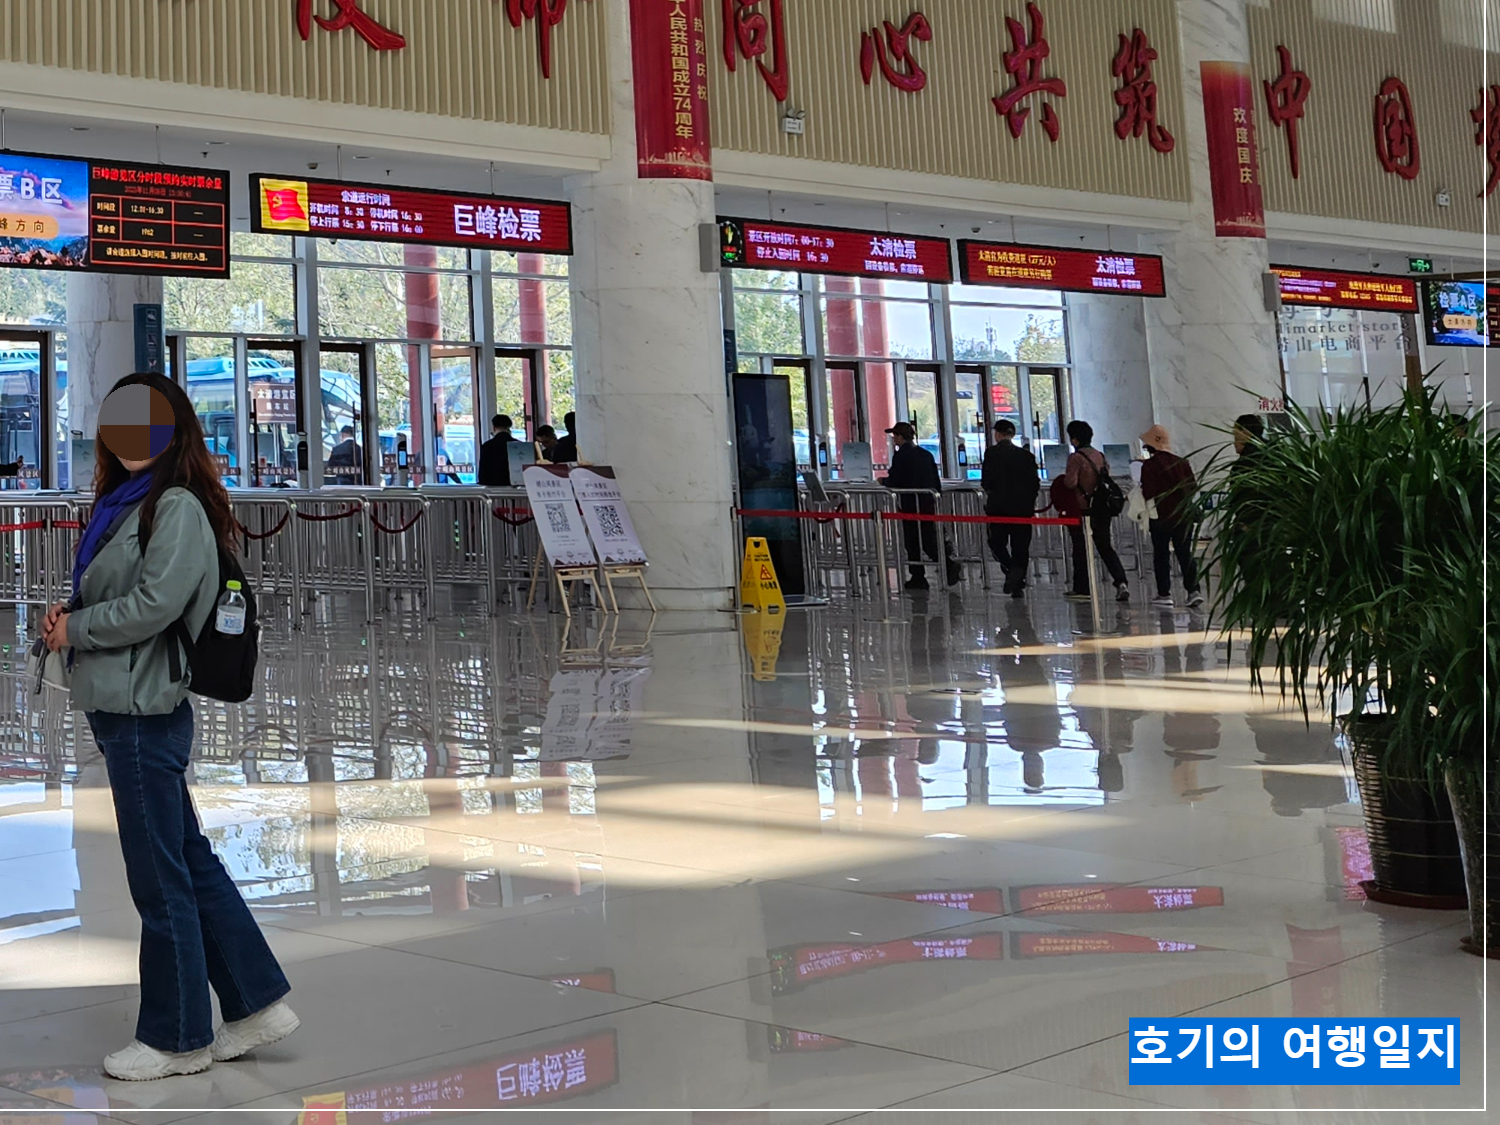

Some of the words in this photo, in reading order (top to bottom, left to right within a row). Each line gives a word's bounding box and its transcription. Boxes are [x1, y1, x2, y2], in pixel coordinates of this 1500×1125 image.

[693, 17, 707, 100] 热烈庆祝
[1233, 107, 1253, 184] 欢度国庆
[453, 203, 542, 242] 巨峰检票
[870, 236, 917, 260] 太清检票
[1095, 255, 1136, 276] 太清检票
[1363, 320, 1410, 332] store
